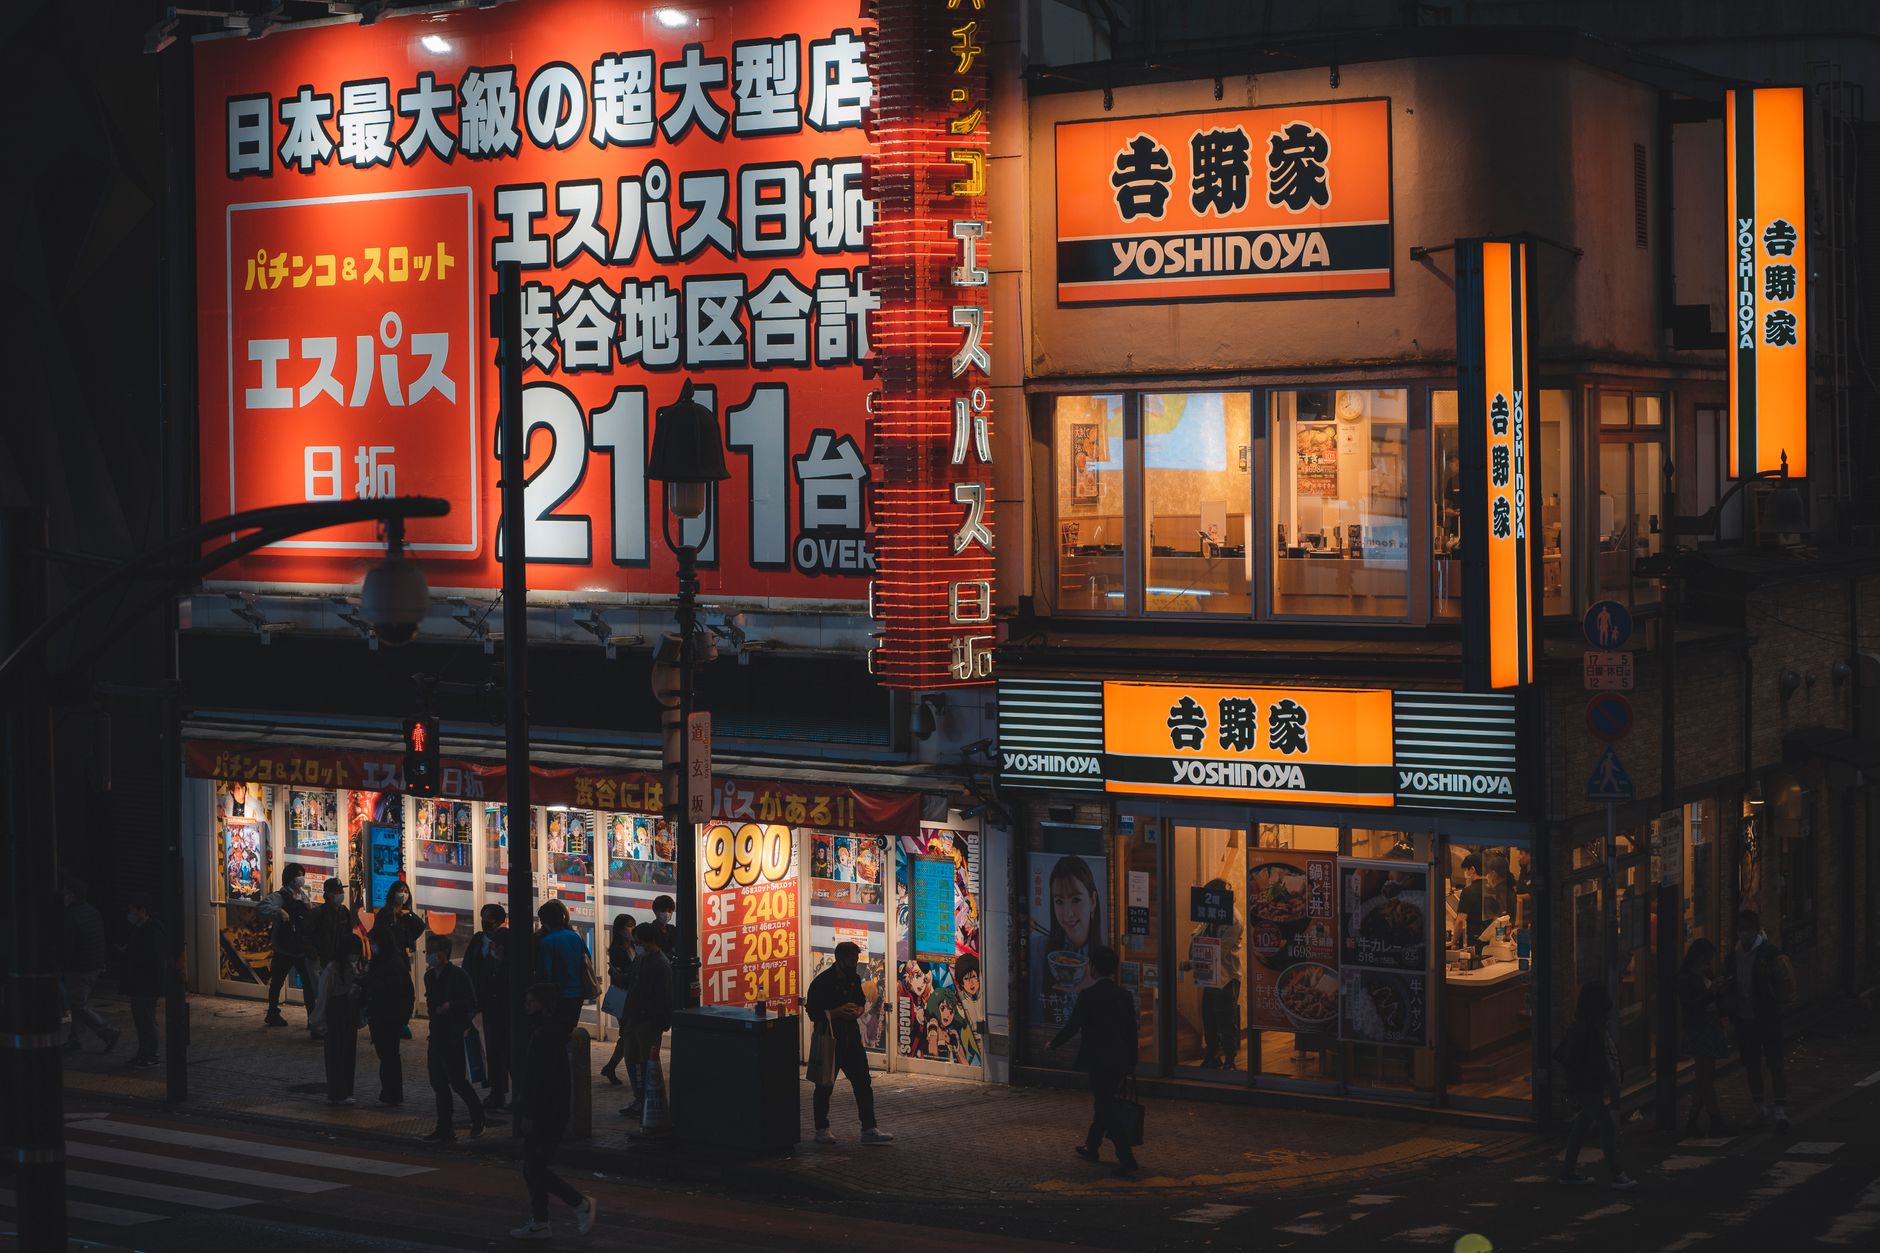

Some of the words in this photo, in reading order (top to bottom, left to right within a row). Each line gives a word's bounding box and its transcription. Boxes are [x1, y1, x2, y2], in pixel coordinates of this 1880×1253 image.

[227, 31, 873, 176] 日本最大級の超大型店
[947, 0, 987, 196] チンコ
[244, 242, 456, 291] パチンコ&スロット
[1112, 232, 1331, 276] YOSHINOYA
[1737, 218, 1754, 349] YOSHINOYA
[245, 311, 456, 409] エスパス
[1513, 391, 1526, 540] YOSHINOYA
[691, 722, 704, 813] 道玄坂
[1003, 753, 1101, 775] YOSHINOYA
[1172, 760, 1307, 790] YOSHINOYA
[1399, 771, 1513, 795] YOSHINOYA
[704, 823, 793, 891] 990
[967, 834, 980, 894] GUNDAM
[707, 892, 737, 926] 3F
[742, 890, 788, 925] 240
[707, 931, 737, 965] 2F
[743, 928, 789, 963] 203
[708, 969, 738, 1003] 1F
[744, 967, 786, 1001] 311
[1409, 978, 1423, 1032] 牛ハヤシ
[899, 996, 911, 1054] MACROS
